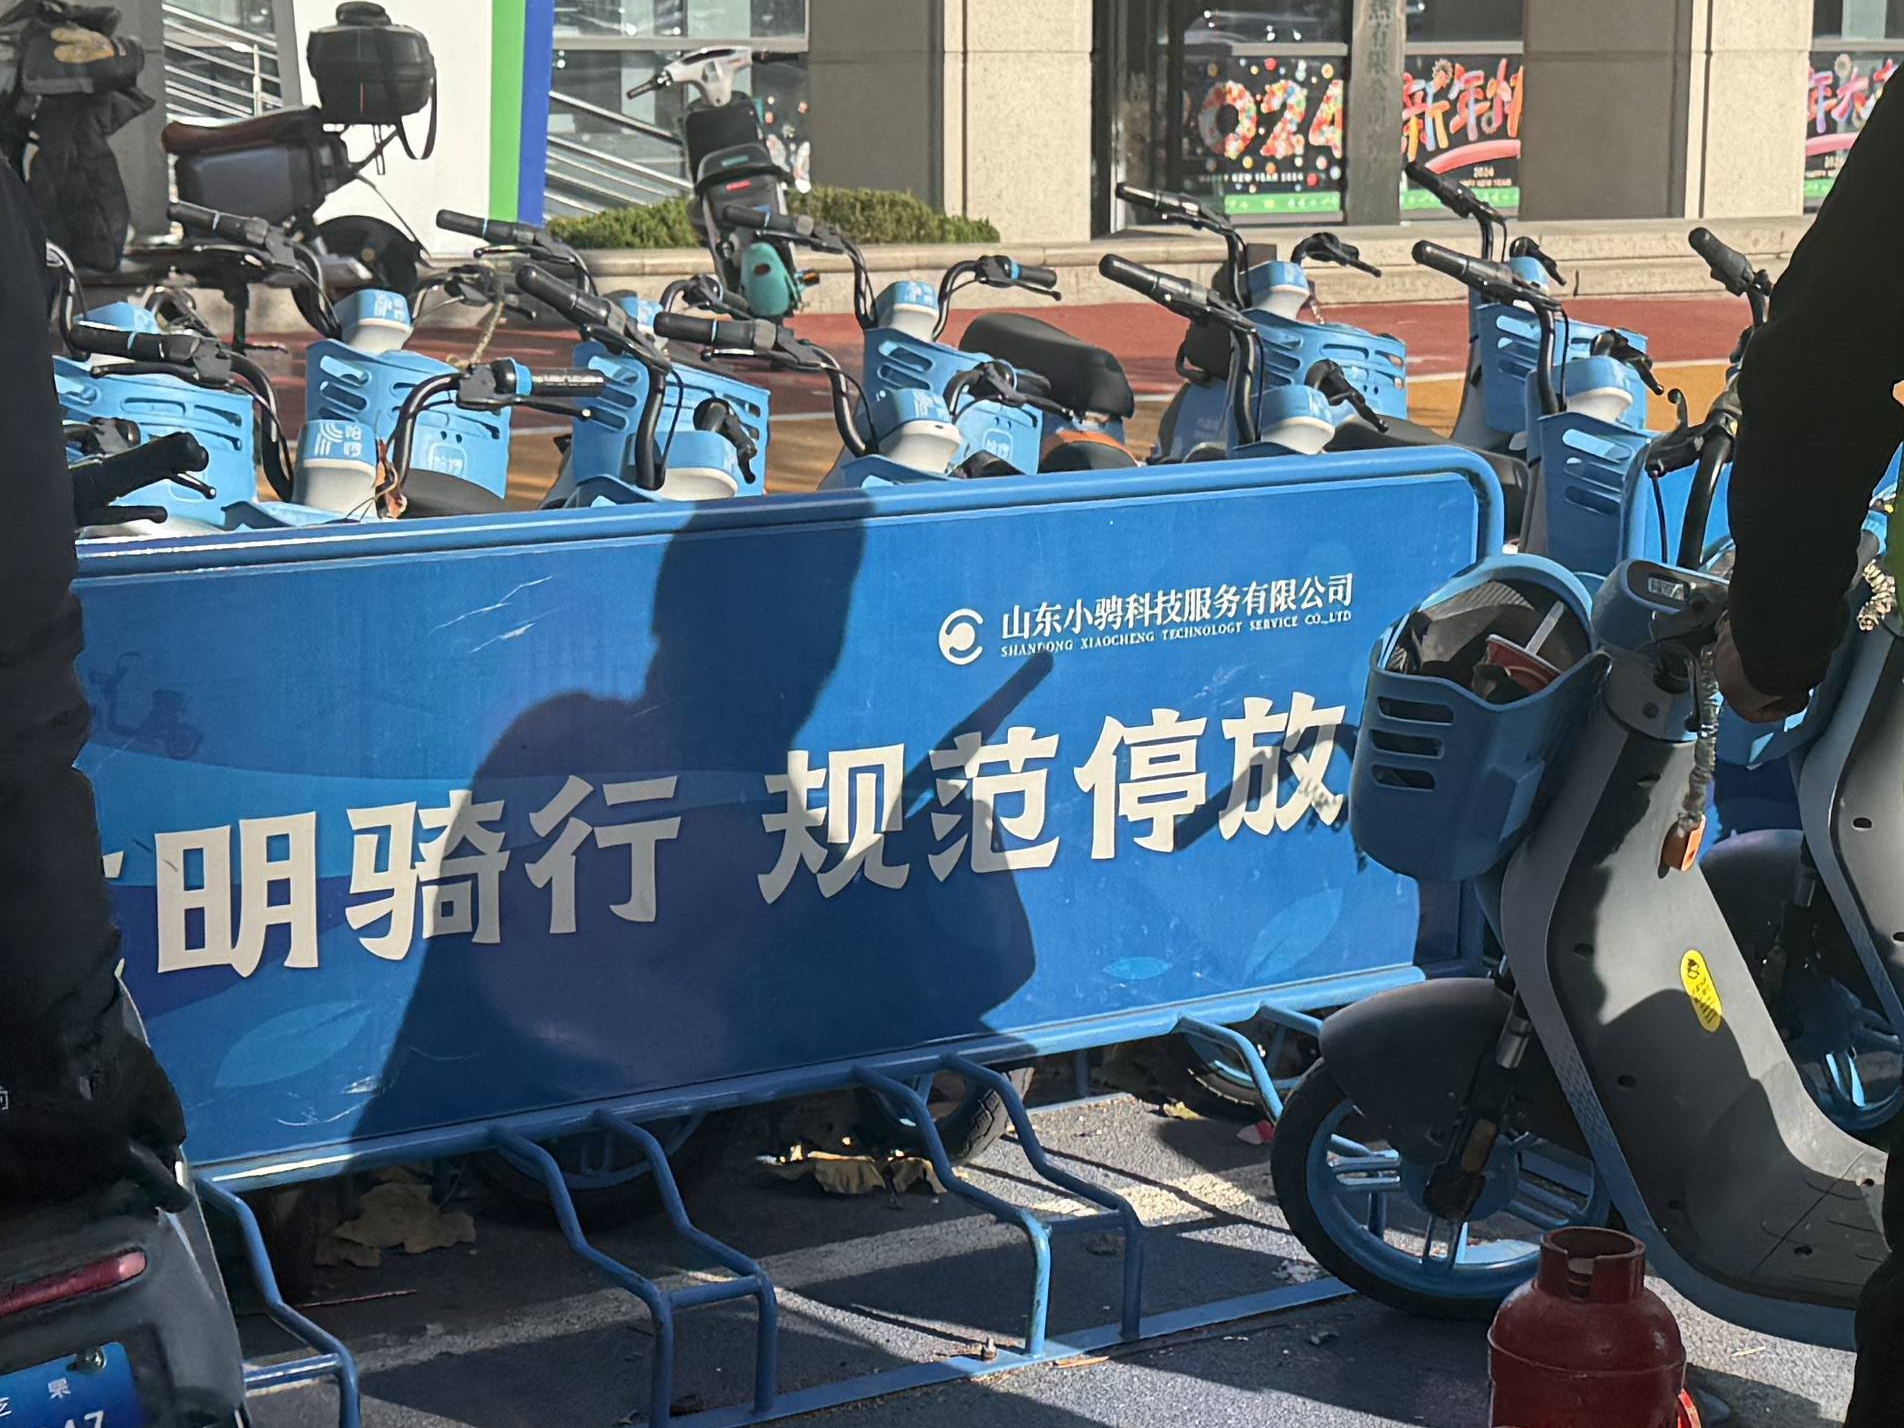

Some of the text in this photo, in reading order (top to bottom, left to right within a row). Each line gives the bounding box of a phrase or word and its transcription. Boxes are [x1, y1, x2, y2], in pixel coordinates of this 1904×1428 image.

[1194, 79, 1344, 160] 024
[1001, 573, 1354, 640] 山东小骋科技服务有限公司
[146, 689, 1350, 979] 明骑行 规范停放
